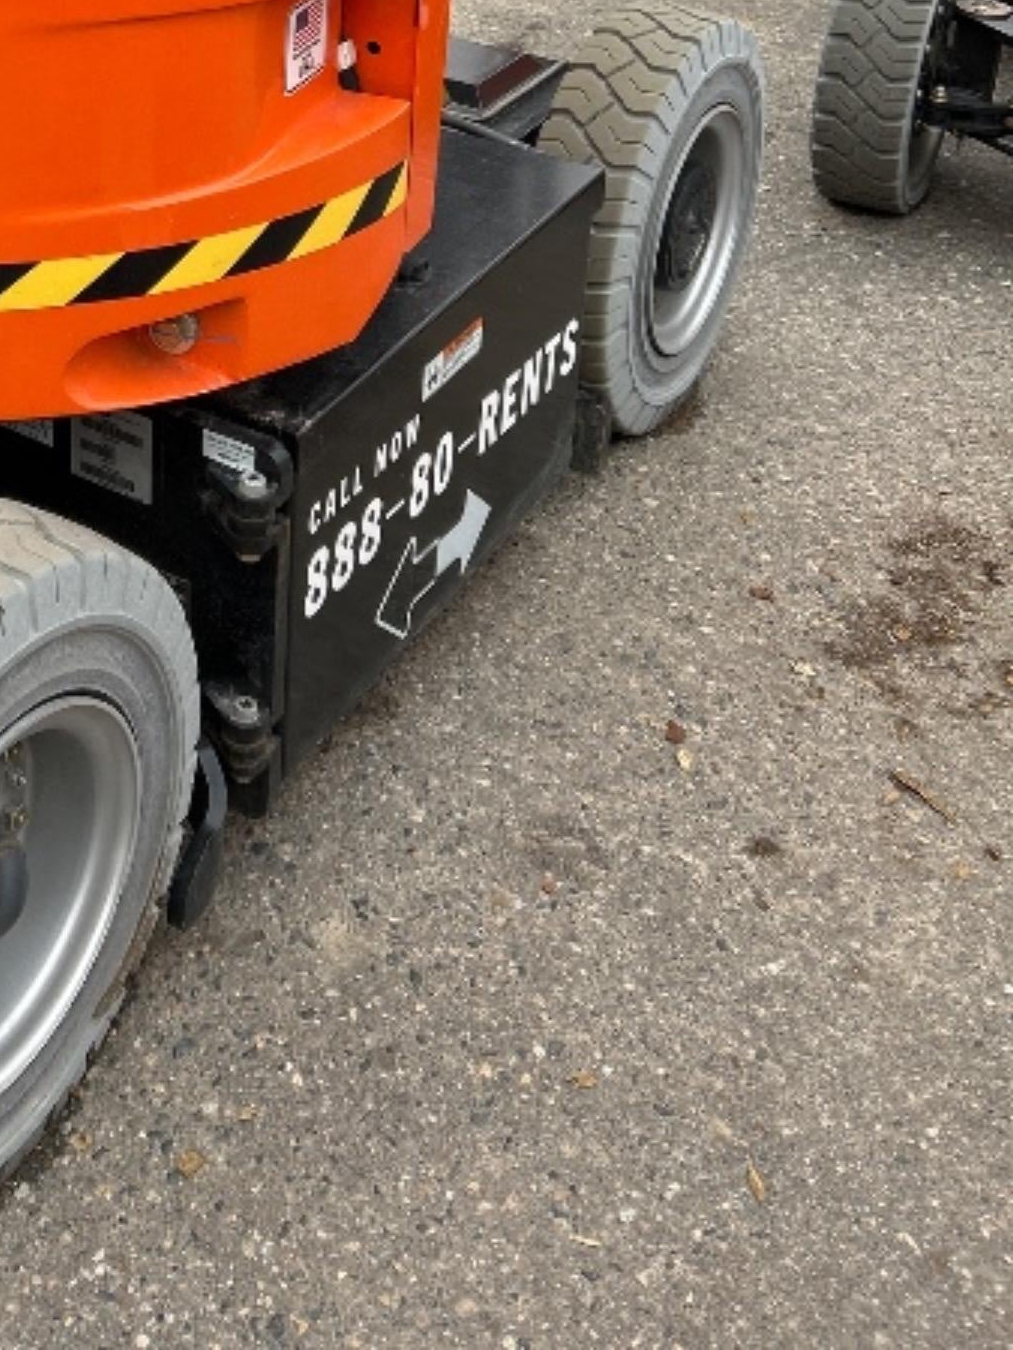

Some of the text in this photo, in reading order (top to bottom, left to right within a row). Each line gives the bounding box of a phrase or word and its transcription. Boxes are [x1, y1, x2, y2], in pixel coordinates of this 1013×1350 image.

[302, 318, 580, 620] 888-80-RENTS
[308, 413, 421, 536] CALL NOW
